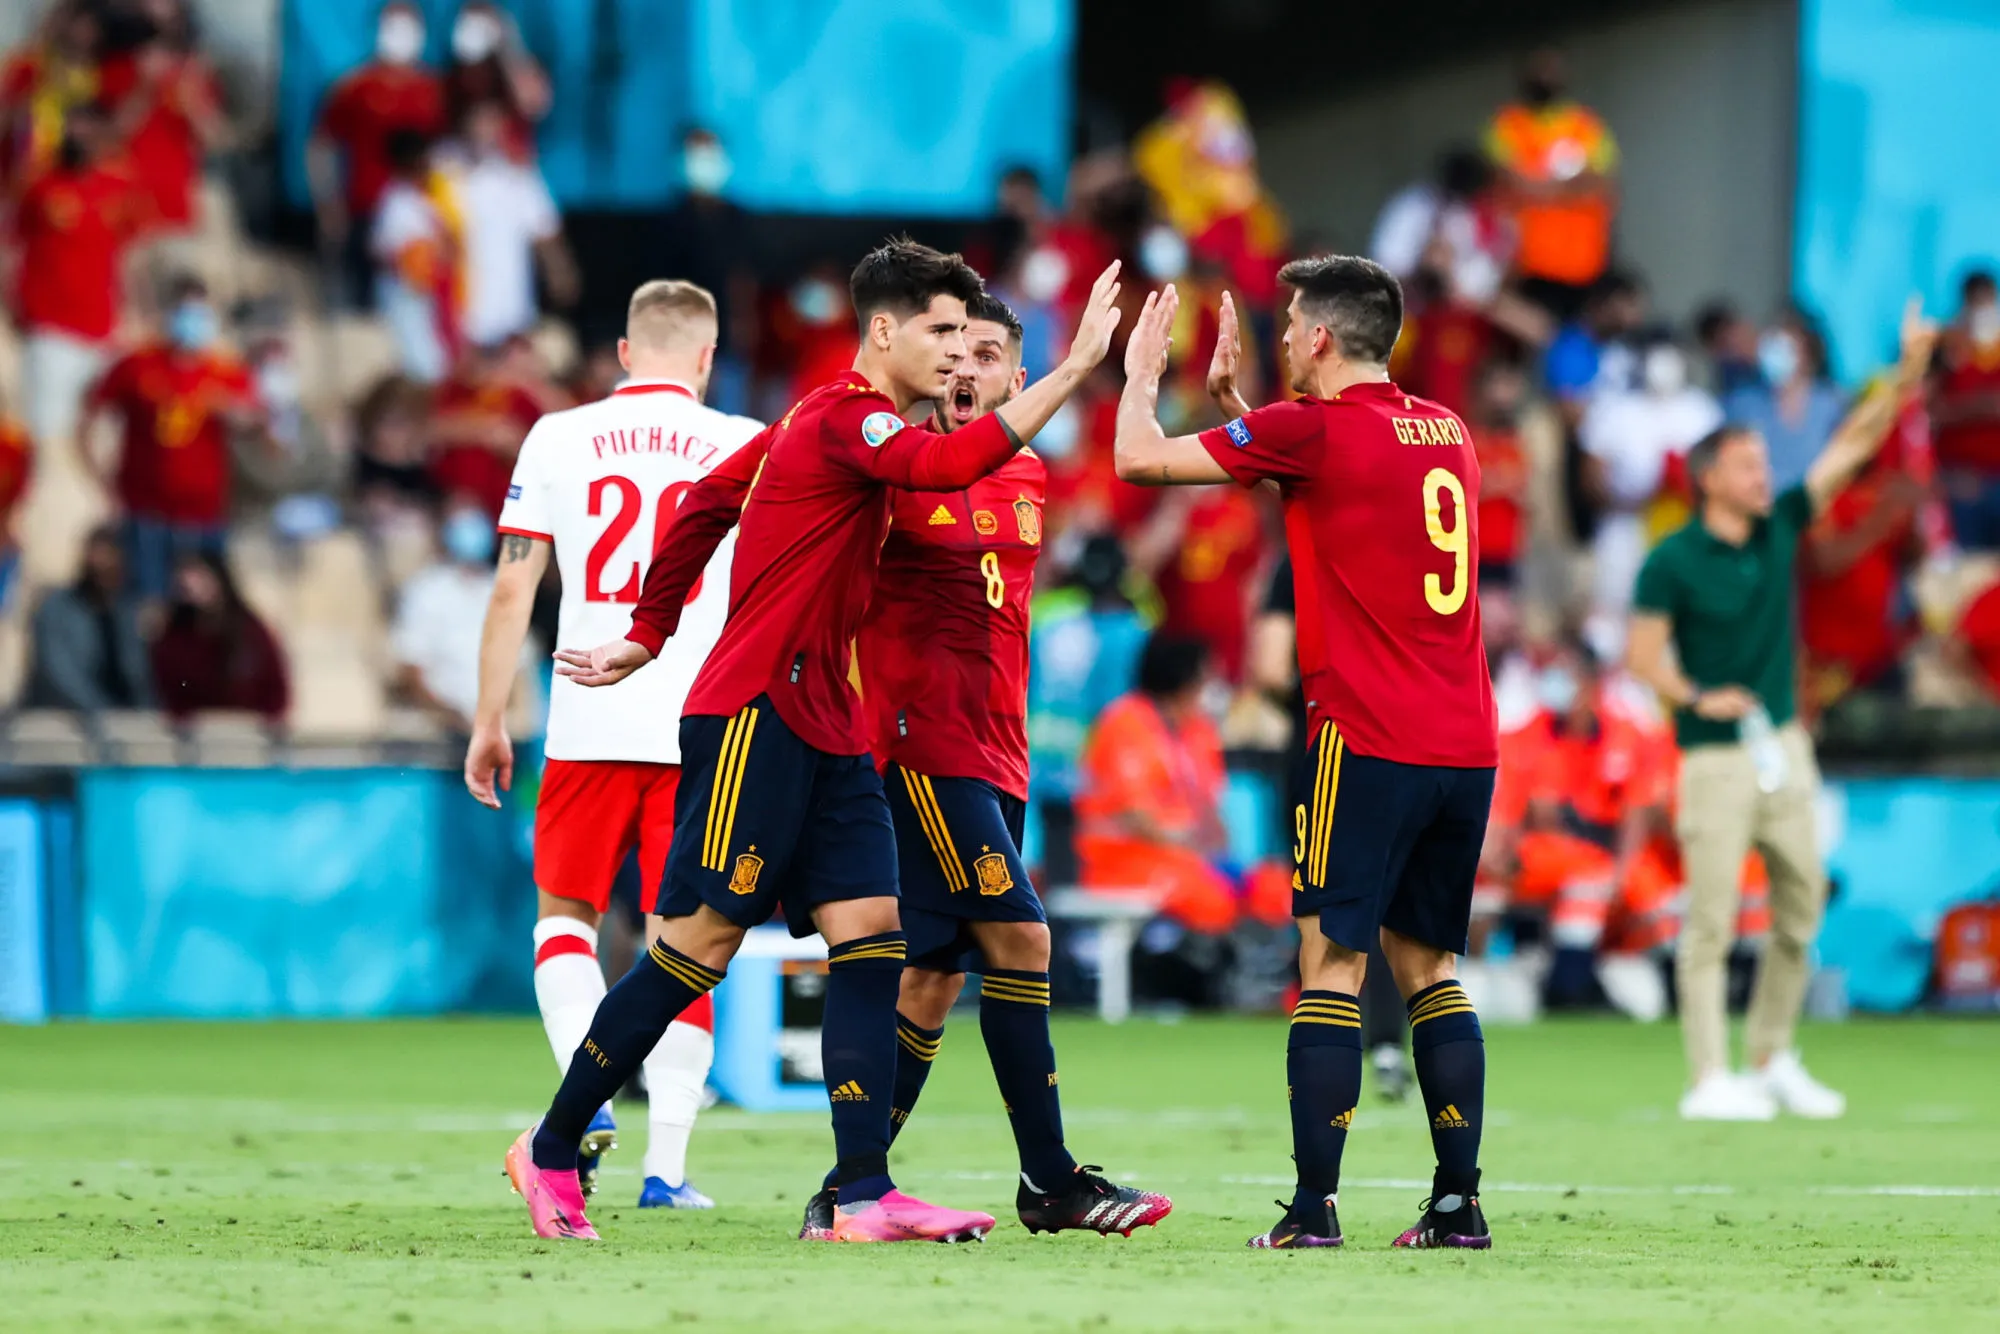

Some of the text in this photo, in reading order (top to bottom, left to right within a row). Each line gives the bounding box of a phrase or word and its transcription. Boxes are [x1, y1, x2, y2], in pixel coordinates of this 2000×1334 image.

[592, 426, 719, 470] PUCHACZ
[1230, 422, 1248, 445] SPECT
[1391, 416, 1464, 446] GERARD
[1422, 467, 1469, 615] 9
[981, 551, 1004, 609] 8
[1294, 803, 1306, 864] 9
[831, 1093, 869, 1102] adidas
